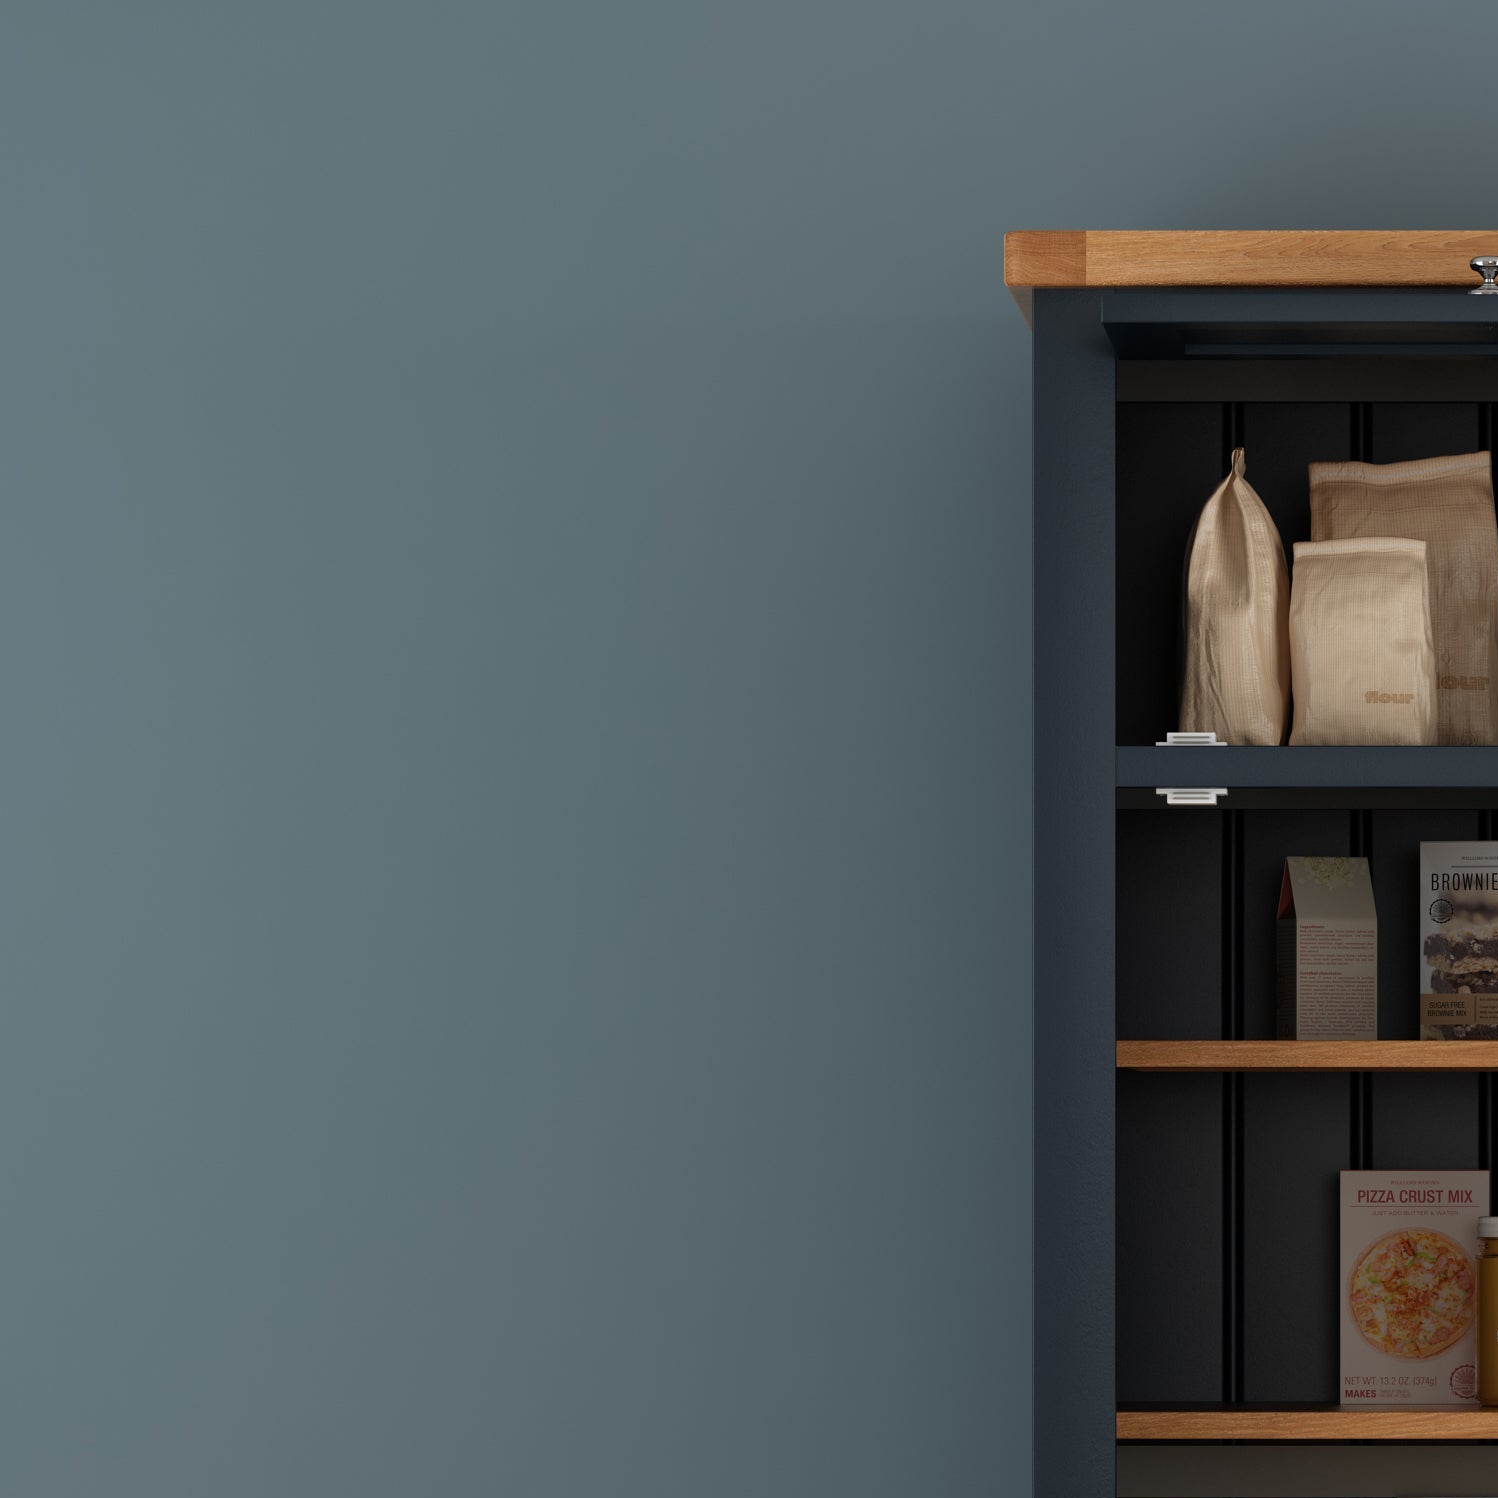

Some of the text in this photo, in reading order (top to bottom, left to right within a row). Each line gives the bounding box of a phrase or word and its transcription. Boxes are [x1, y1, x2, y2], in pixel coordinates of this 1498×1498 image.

[1364, 690, 1415, 705] flour
[1431, 872, 1498, 891] BROWNIE
[1430, 1001, 1465, 1009] SUGAR FREE
[1357, 1189, 1474, 1204] PIZZA CRUST MIX
[1344, 1376, 1360, 1385] NET
[1380, 1376, 1397, 1386] 13.2
[1344, 1389, 1377, 1399] MAKES
